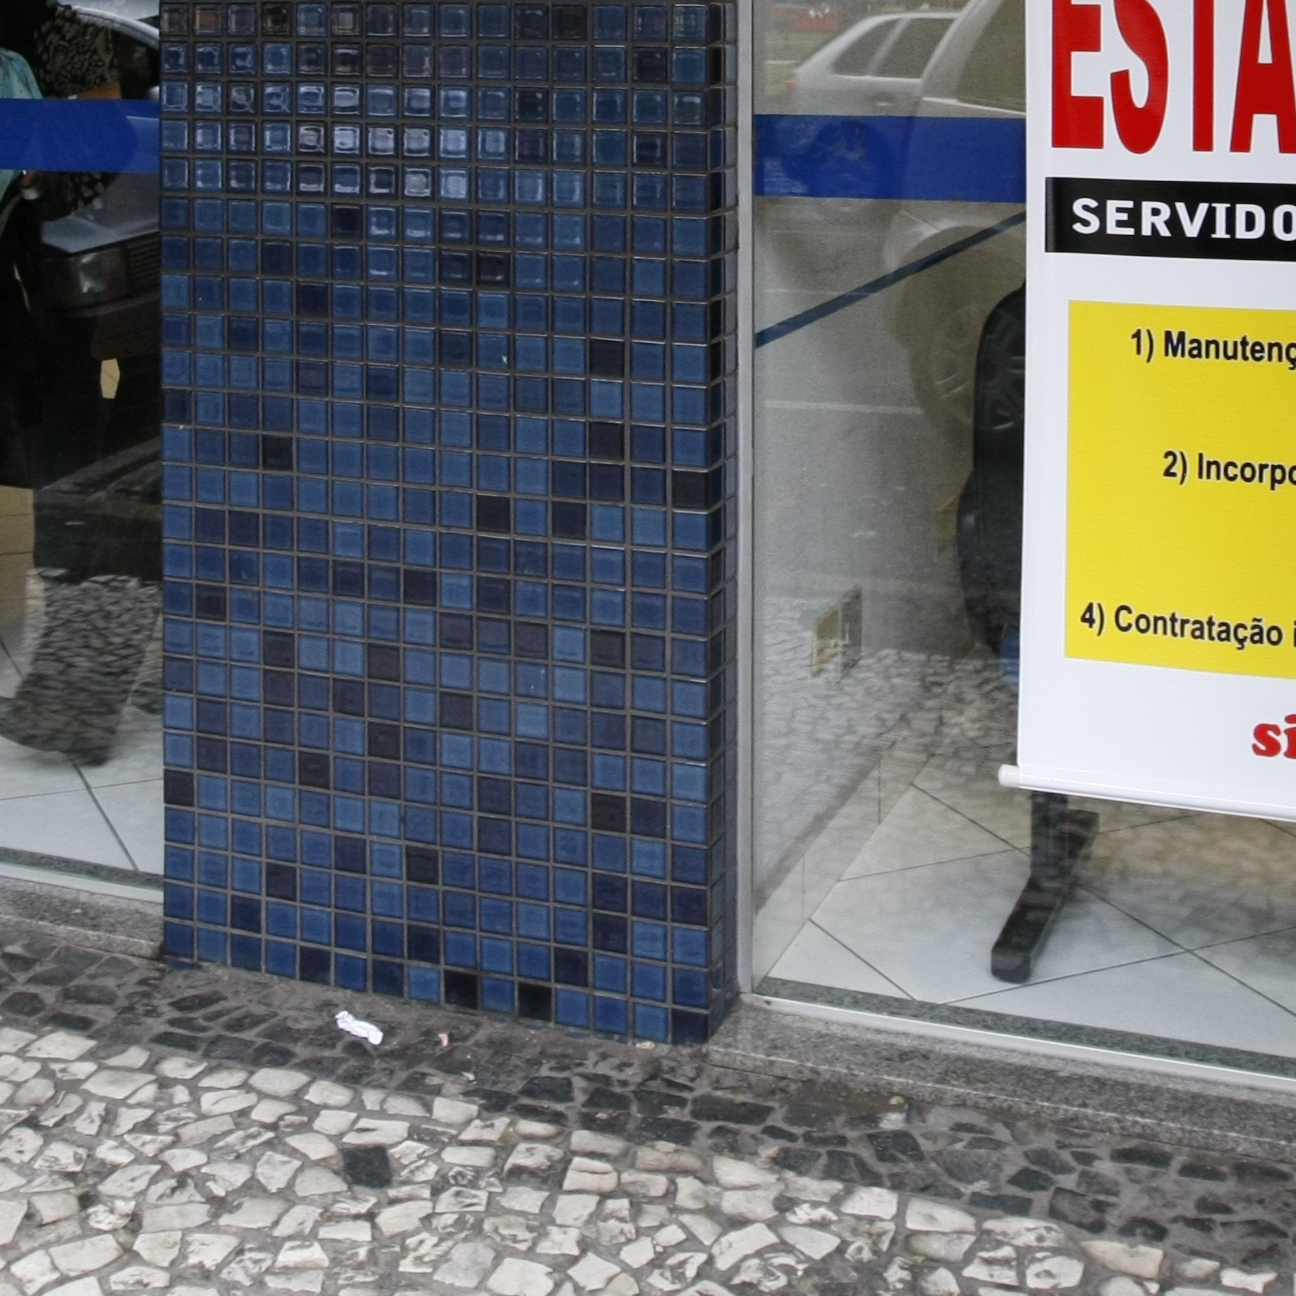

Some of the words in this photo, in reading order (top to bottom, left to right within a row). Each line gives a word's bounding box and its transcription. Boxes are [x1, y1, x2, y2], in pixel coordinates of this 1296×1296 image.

[1130, 328, 1155, 364] 1)
[1162, 450, 1188, 485] 2)
[1080, 602, 1105, 636] 4)
[1114, 604, 1283, 651] Contratação
